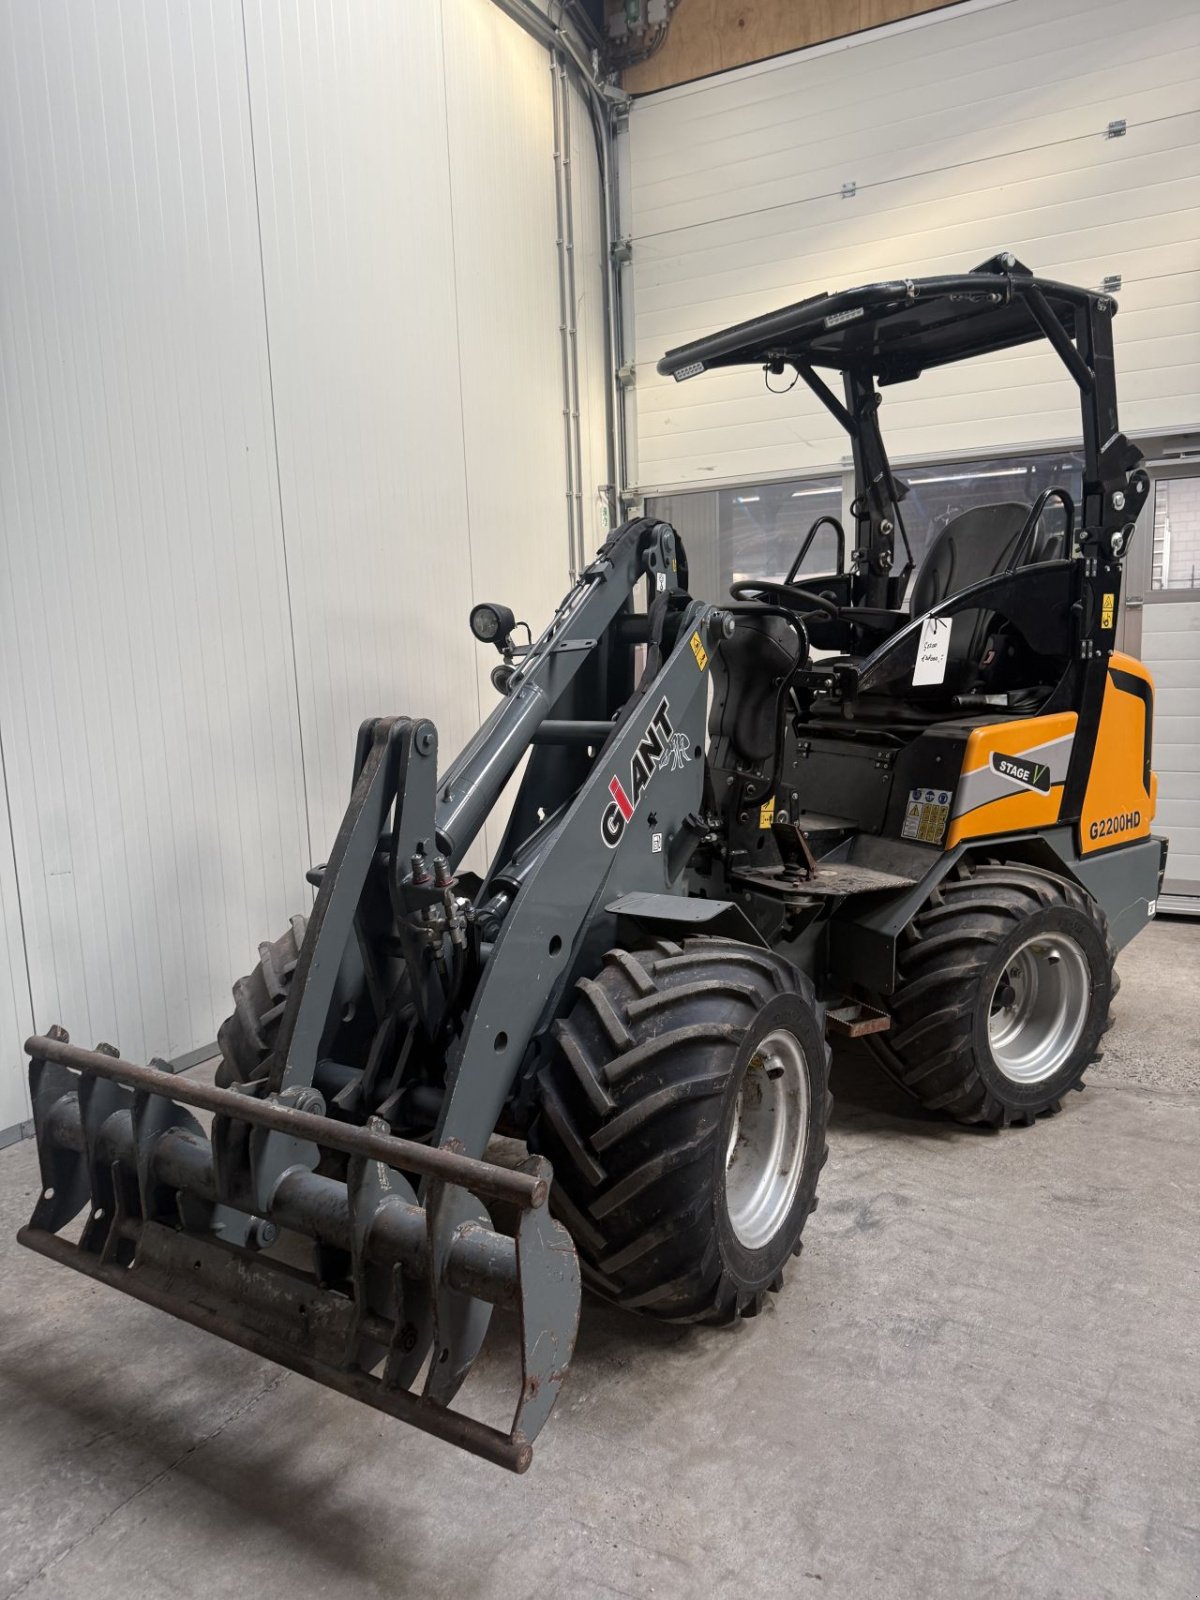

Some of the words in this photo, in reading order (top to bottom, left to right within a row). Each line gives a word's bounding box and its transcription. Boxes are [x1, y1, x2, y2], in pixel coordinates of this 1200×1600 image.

[601, 696, 673, 848] GIANT
[1000, 761, 1030, 781] STAGE
[1032, 763, 1048, 784] V
[1090, 811, 1140, 840] G2200HD
